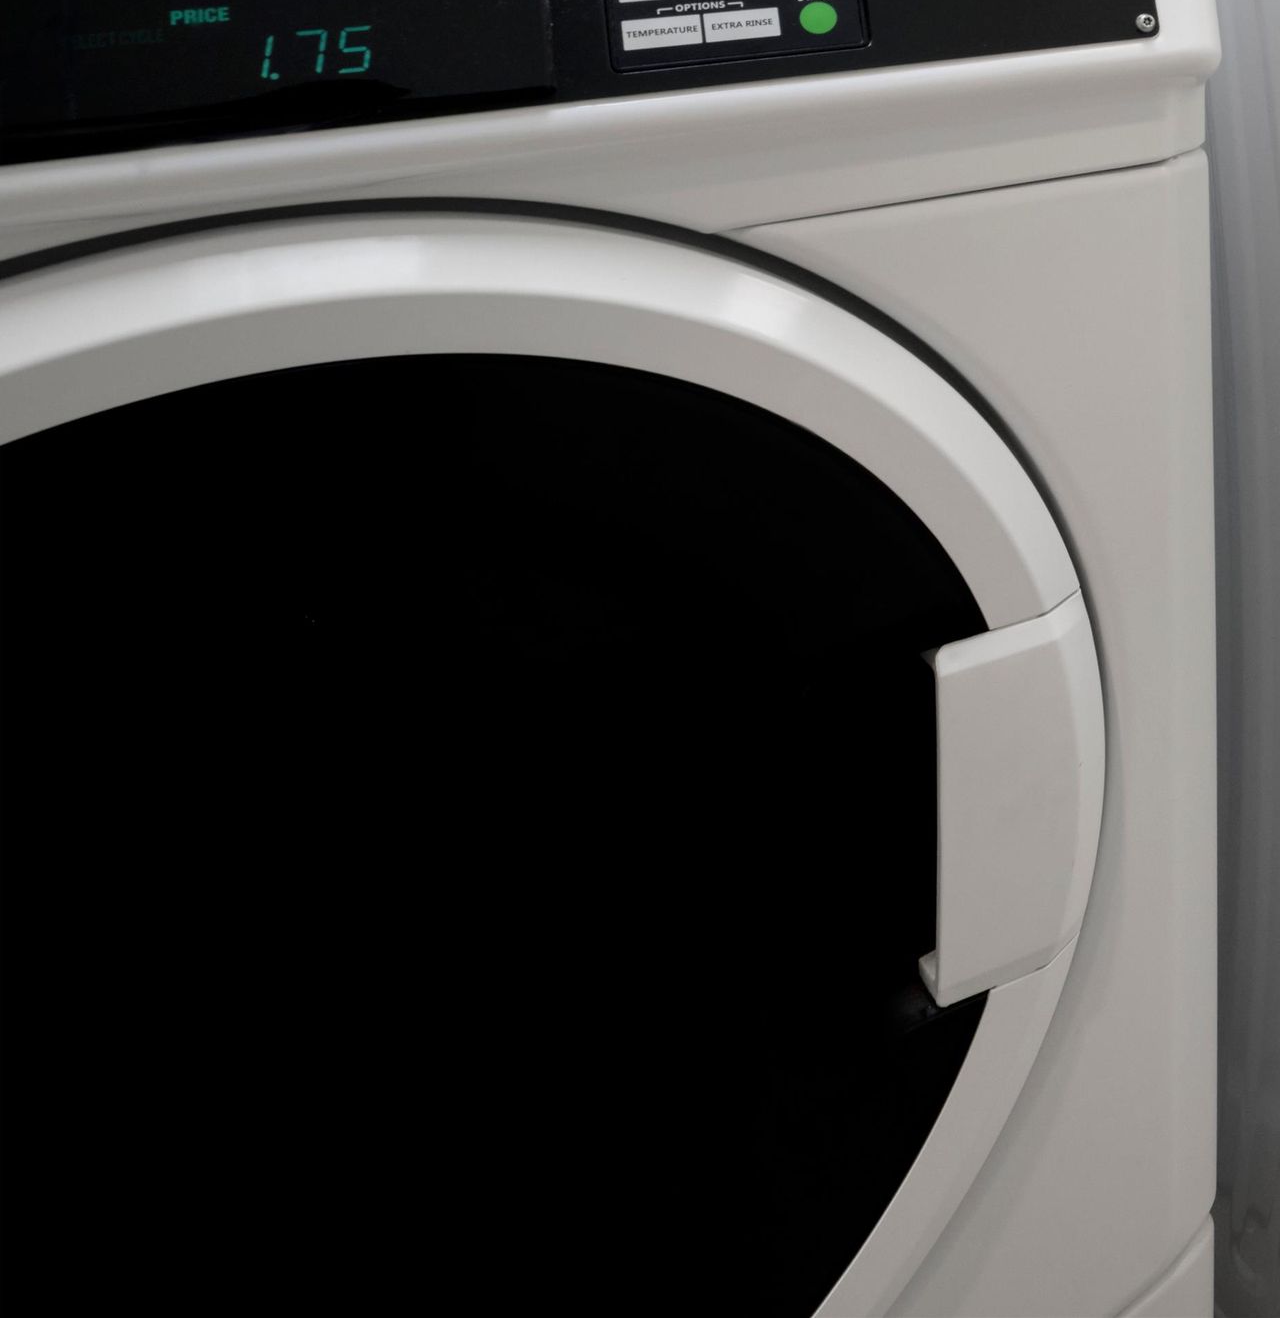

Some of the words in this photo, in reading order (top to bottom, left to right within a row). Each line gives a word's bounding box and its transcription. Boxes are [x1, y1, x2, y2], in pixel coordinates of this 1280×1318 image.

[674, 0, 726, 13] OPTIONS
[169, 7, 231, 26] PRICE
[711, 19, 743, 31] EXTRA
[745, 17, 773, 27] RINSE
[626, 25, 699, 39] TEMPERATURE
[260, 25, 372, 80] 1.75
